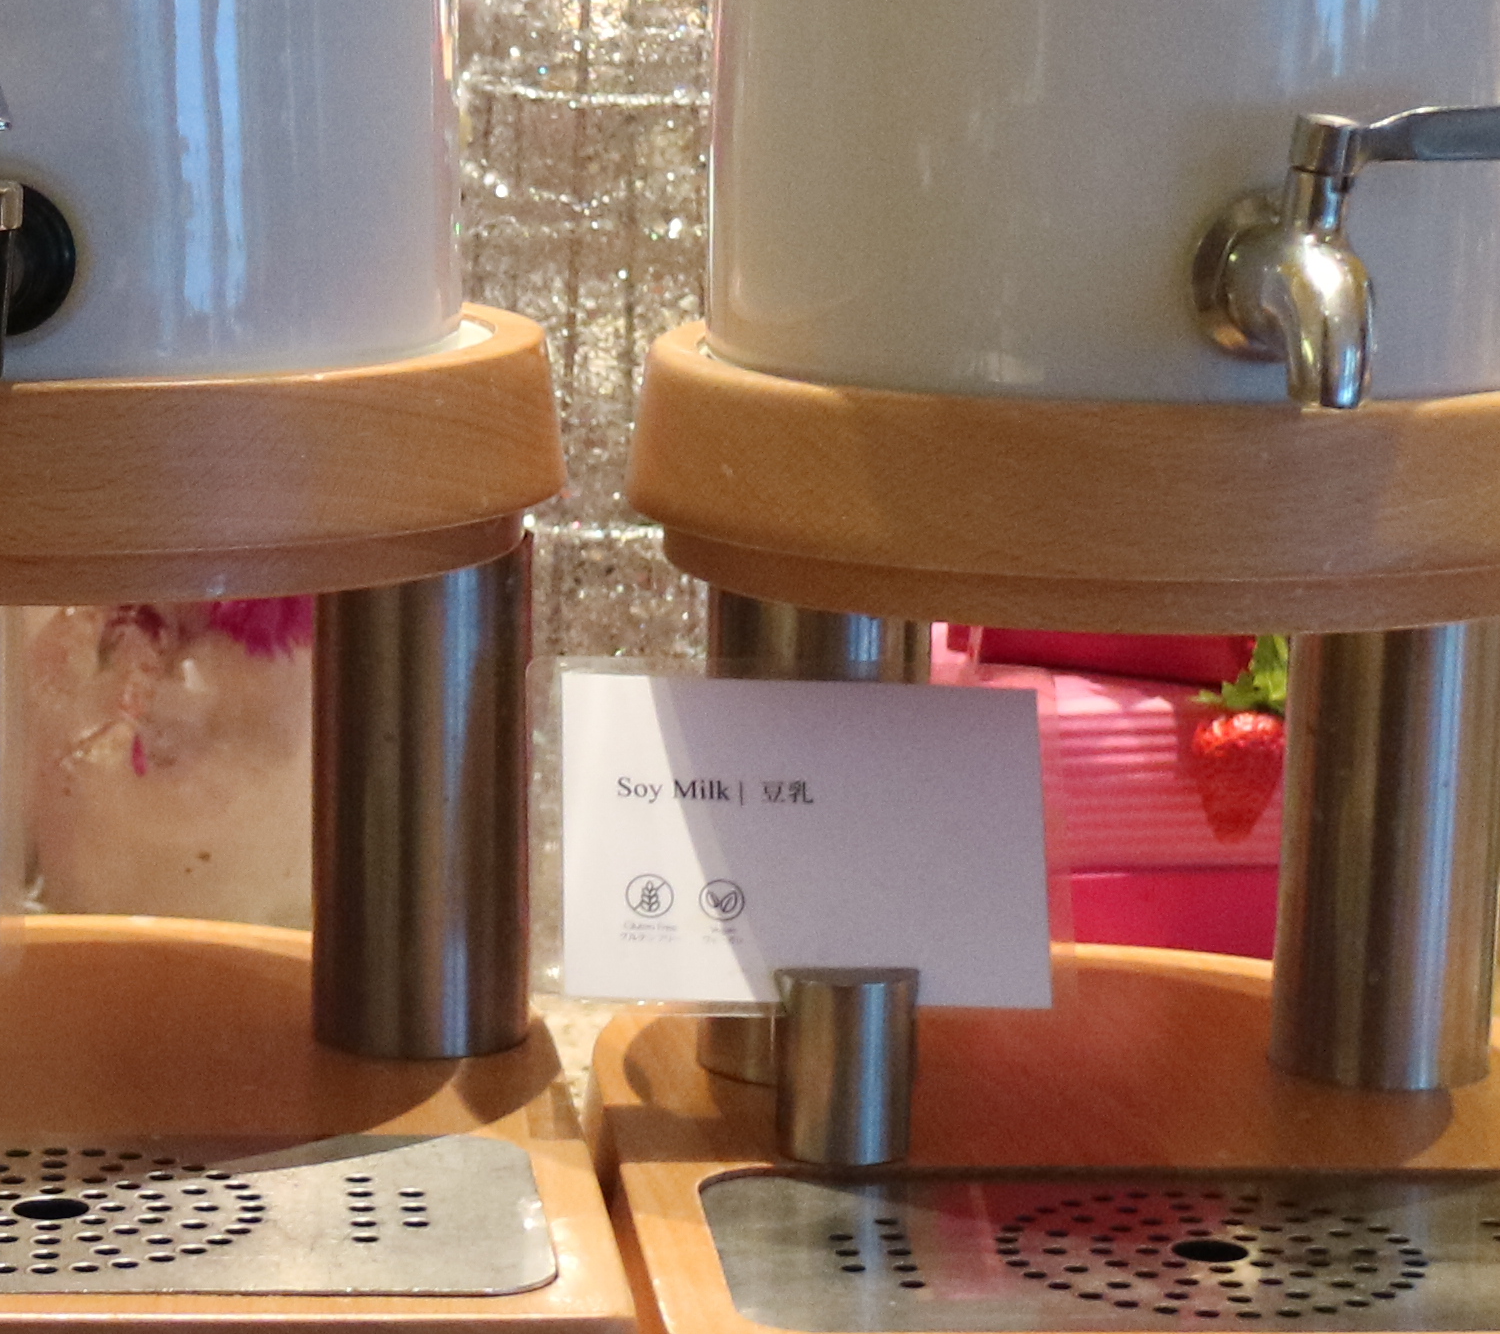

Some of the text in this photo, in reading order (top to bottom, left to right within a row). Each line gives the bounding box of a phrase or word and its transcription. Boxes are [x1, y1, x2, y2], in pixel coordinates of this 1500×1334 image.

[617, 776, 663, 804] Soy
[673, 778, 730, 801] Milk
[762, 779, 814, 804] 豆乳
